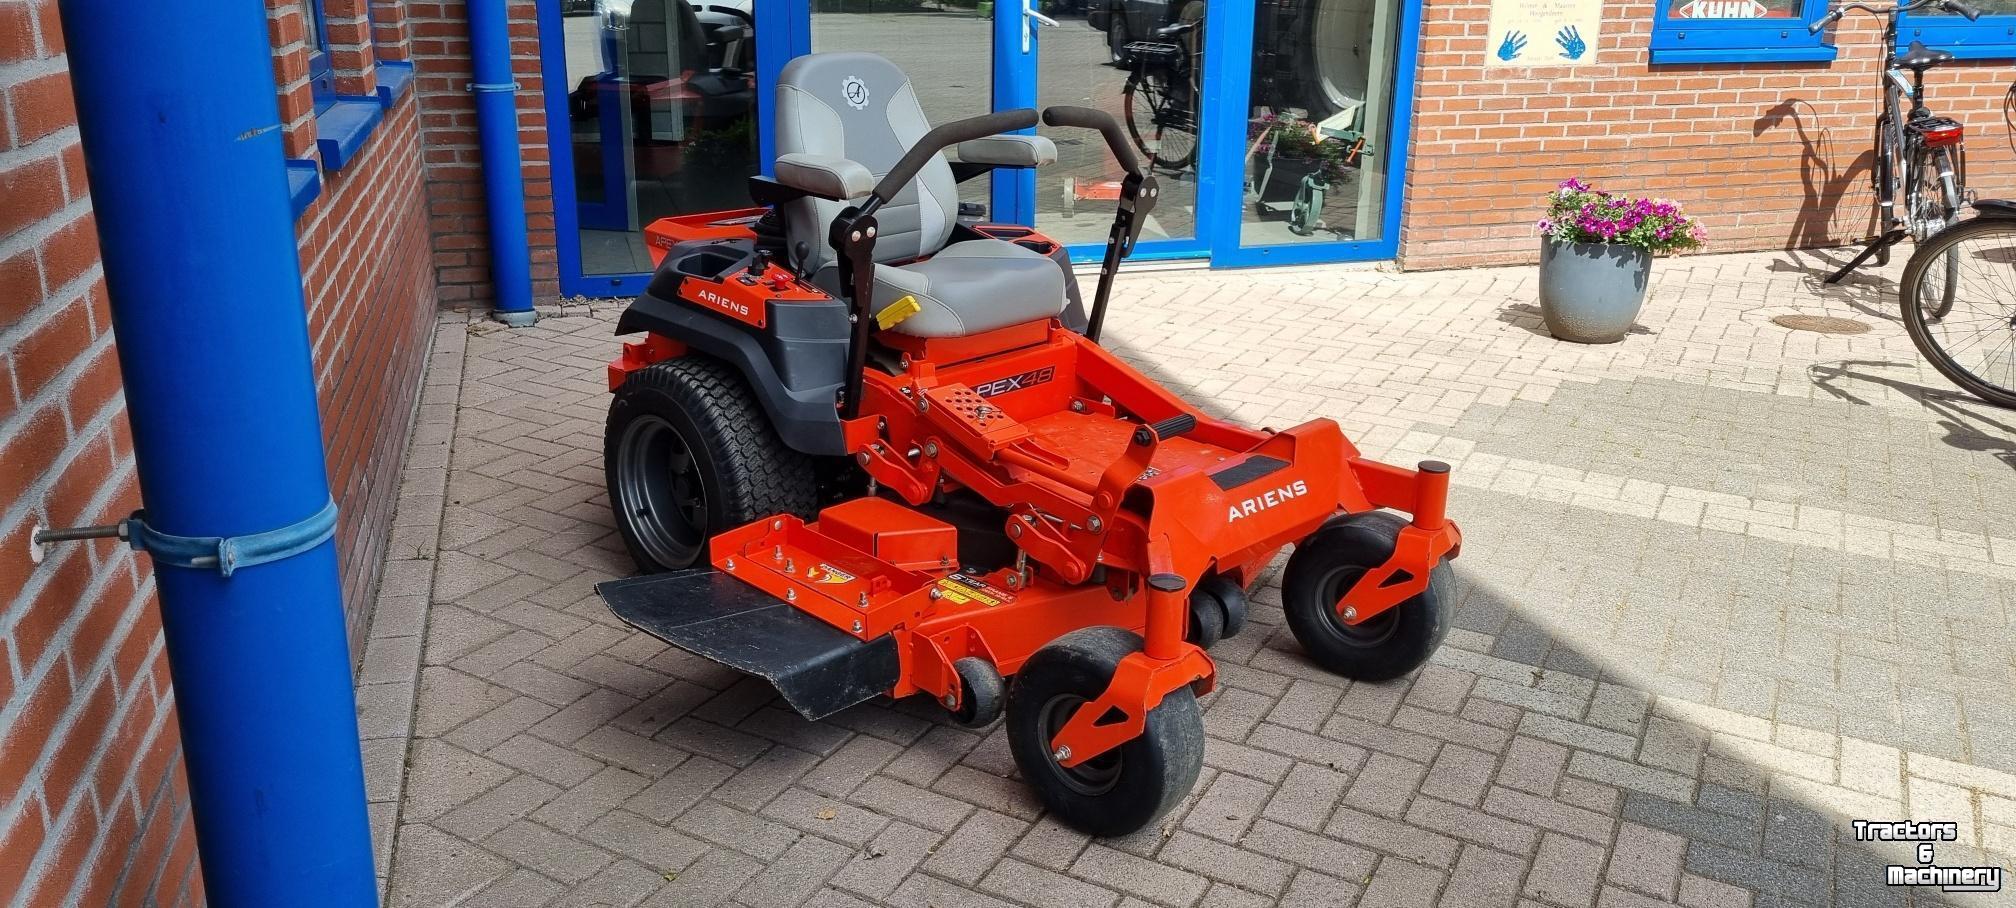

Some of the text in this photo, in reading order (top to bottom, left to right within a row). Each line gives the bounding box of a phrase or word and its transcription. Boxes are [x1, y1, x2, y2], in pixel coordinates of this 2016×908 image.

[1692, 0, 1755, 18] KUHN
[698, 289, 749, 316] ARIENS
[1228, 480, 1308, 523] ARIENS
